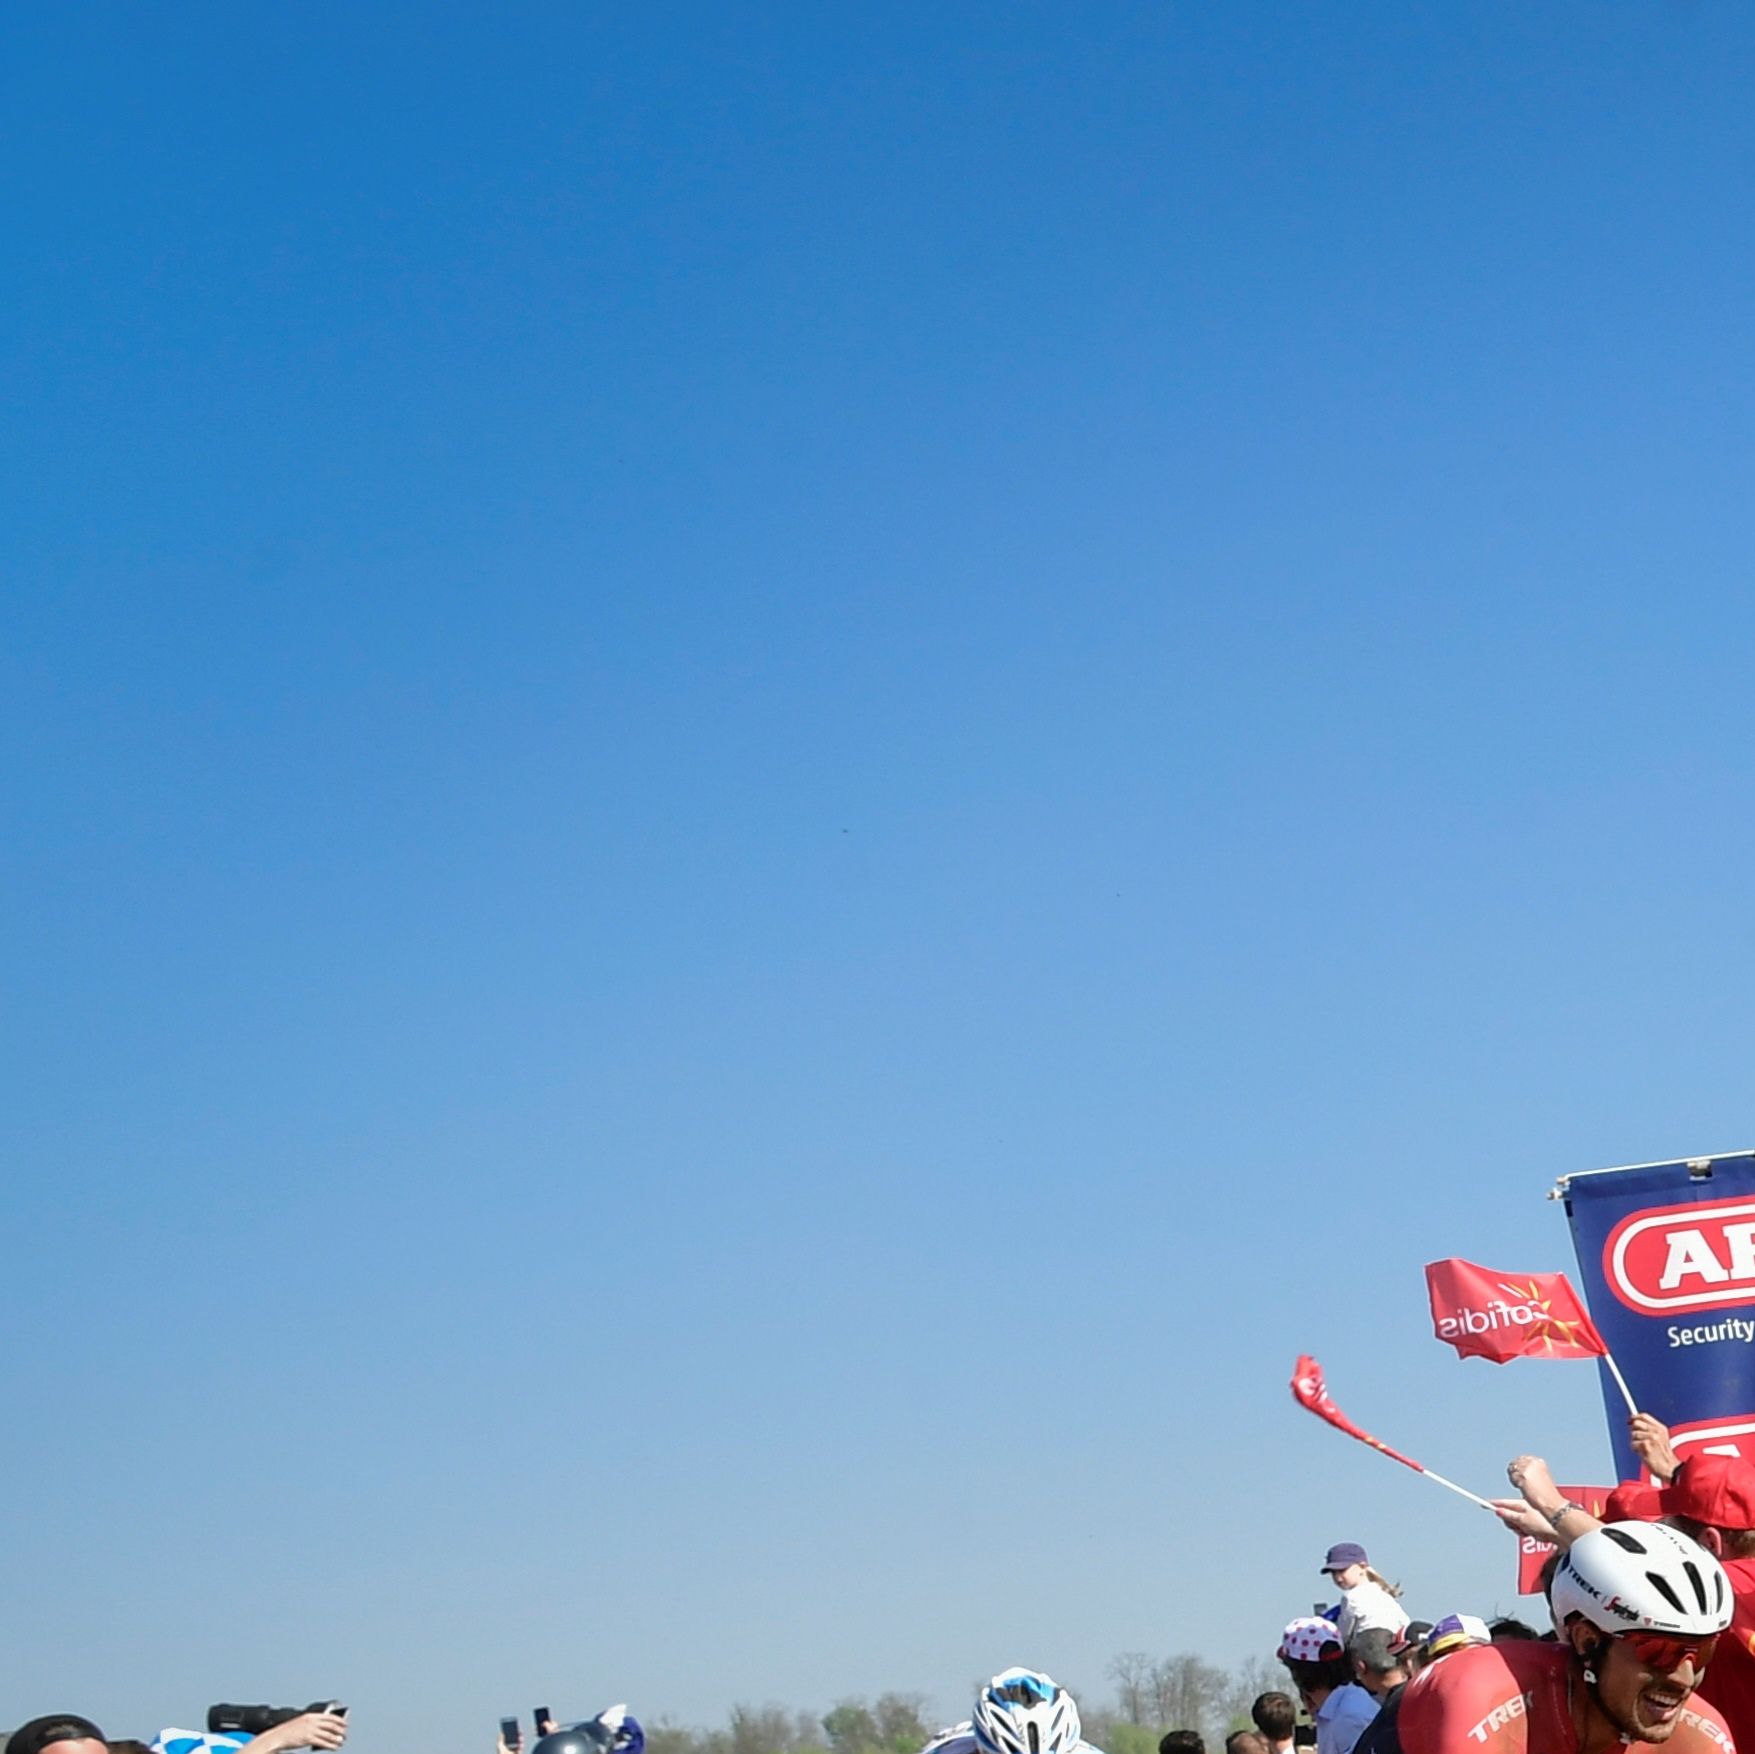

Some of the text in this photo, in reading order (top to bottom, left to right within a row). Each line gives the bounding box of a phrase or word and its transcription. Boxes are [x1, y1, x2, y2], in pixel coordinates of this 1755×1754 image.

[1667, 1317, 1755, 1348] Security
[1568, 1566, 1602, 1600] TREK
[1467, 1691, 1533, 1744] TREK
